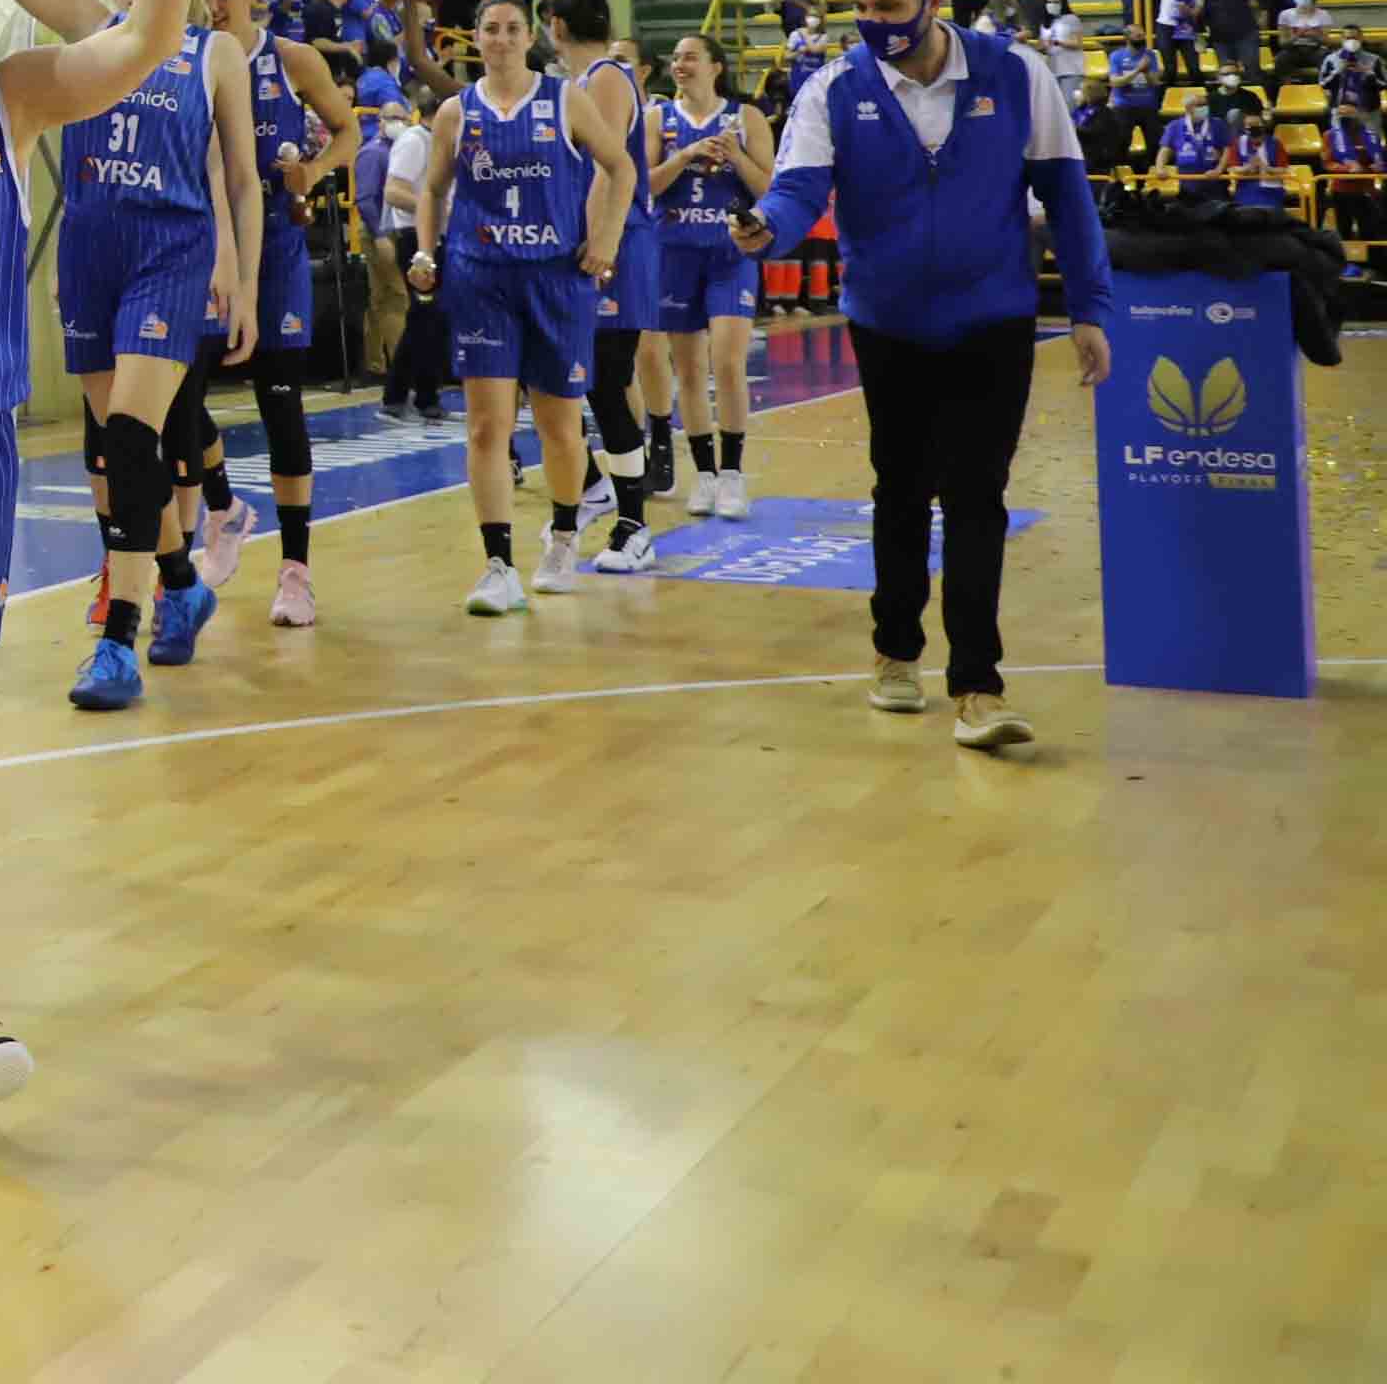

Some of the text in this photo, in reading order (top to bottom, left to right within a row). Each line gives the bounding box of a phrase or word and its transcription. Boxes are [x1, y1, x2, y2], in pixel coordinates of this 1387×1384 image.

[108, 112, 139, 153] 31
[505, 185, 521, 218] 4
[691, 177, 705, 204] 5
